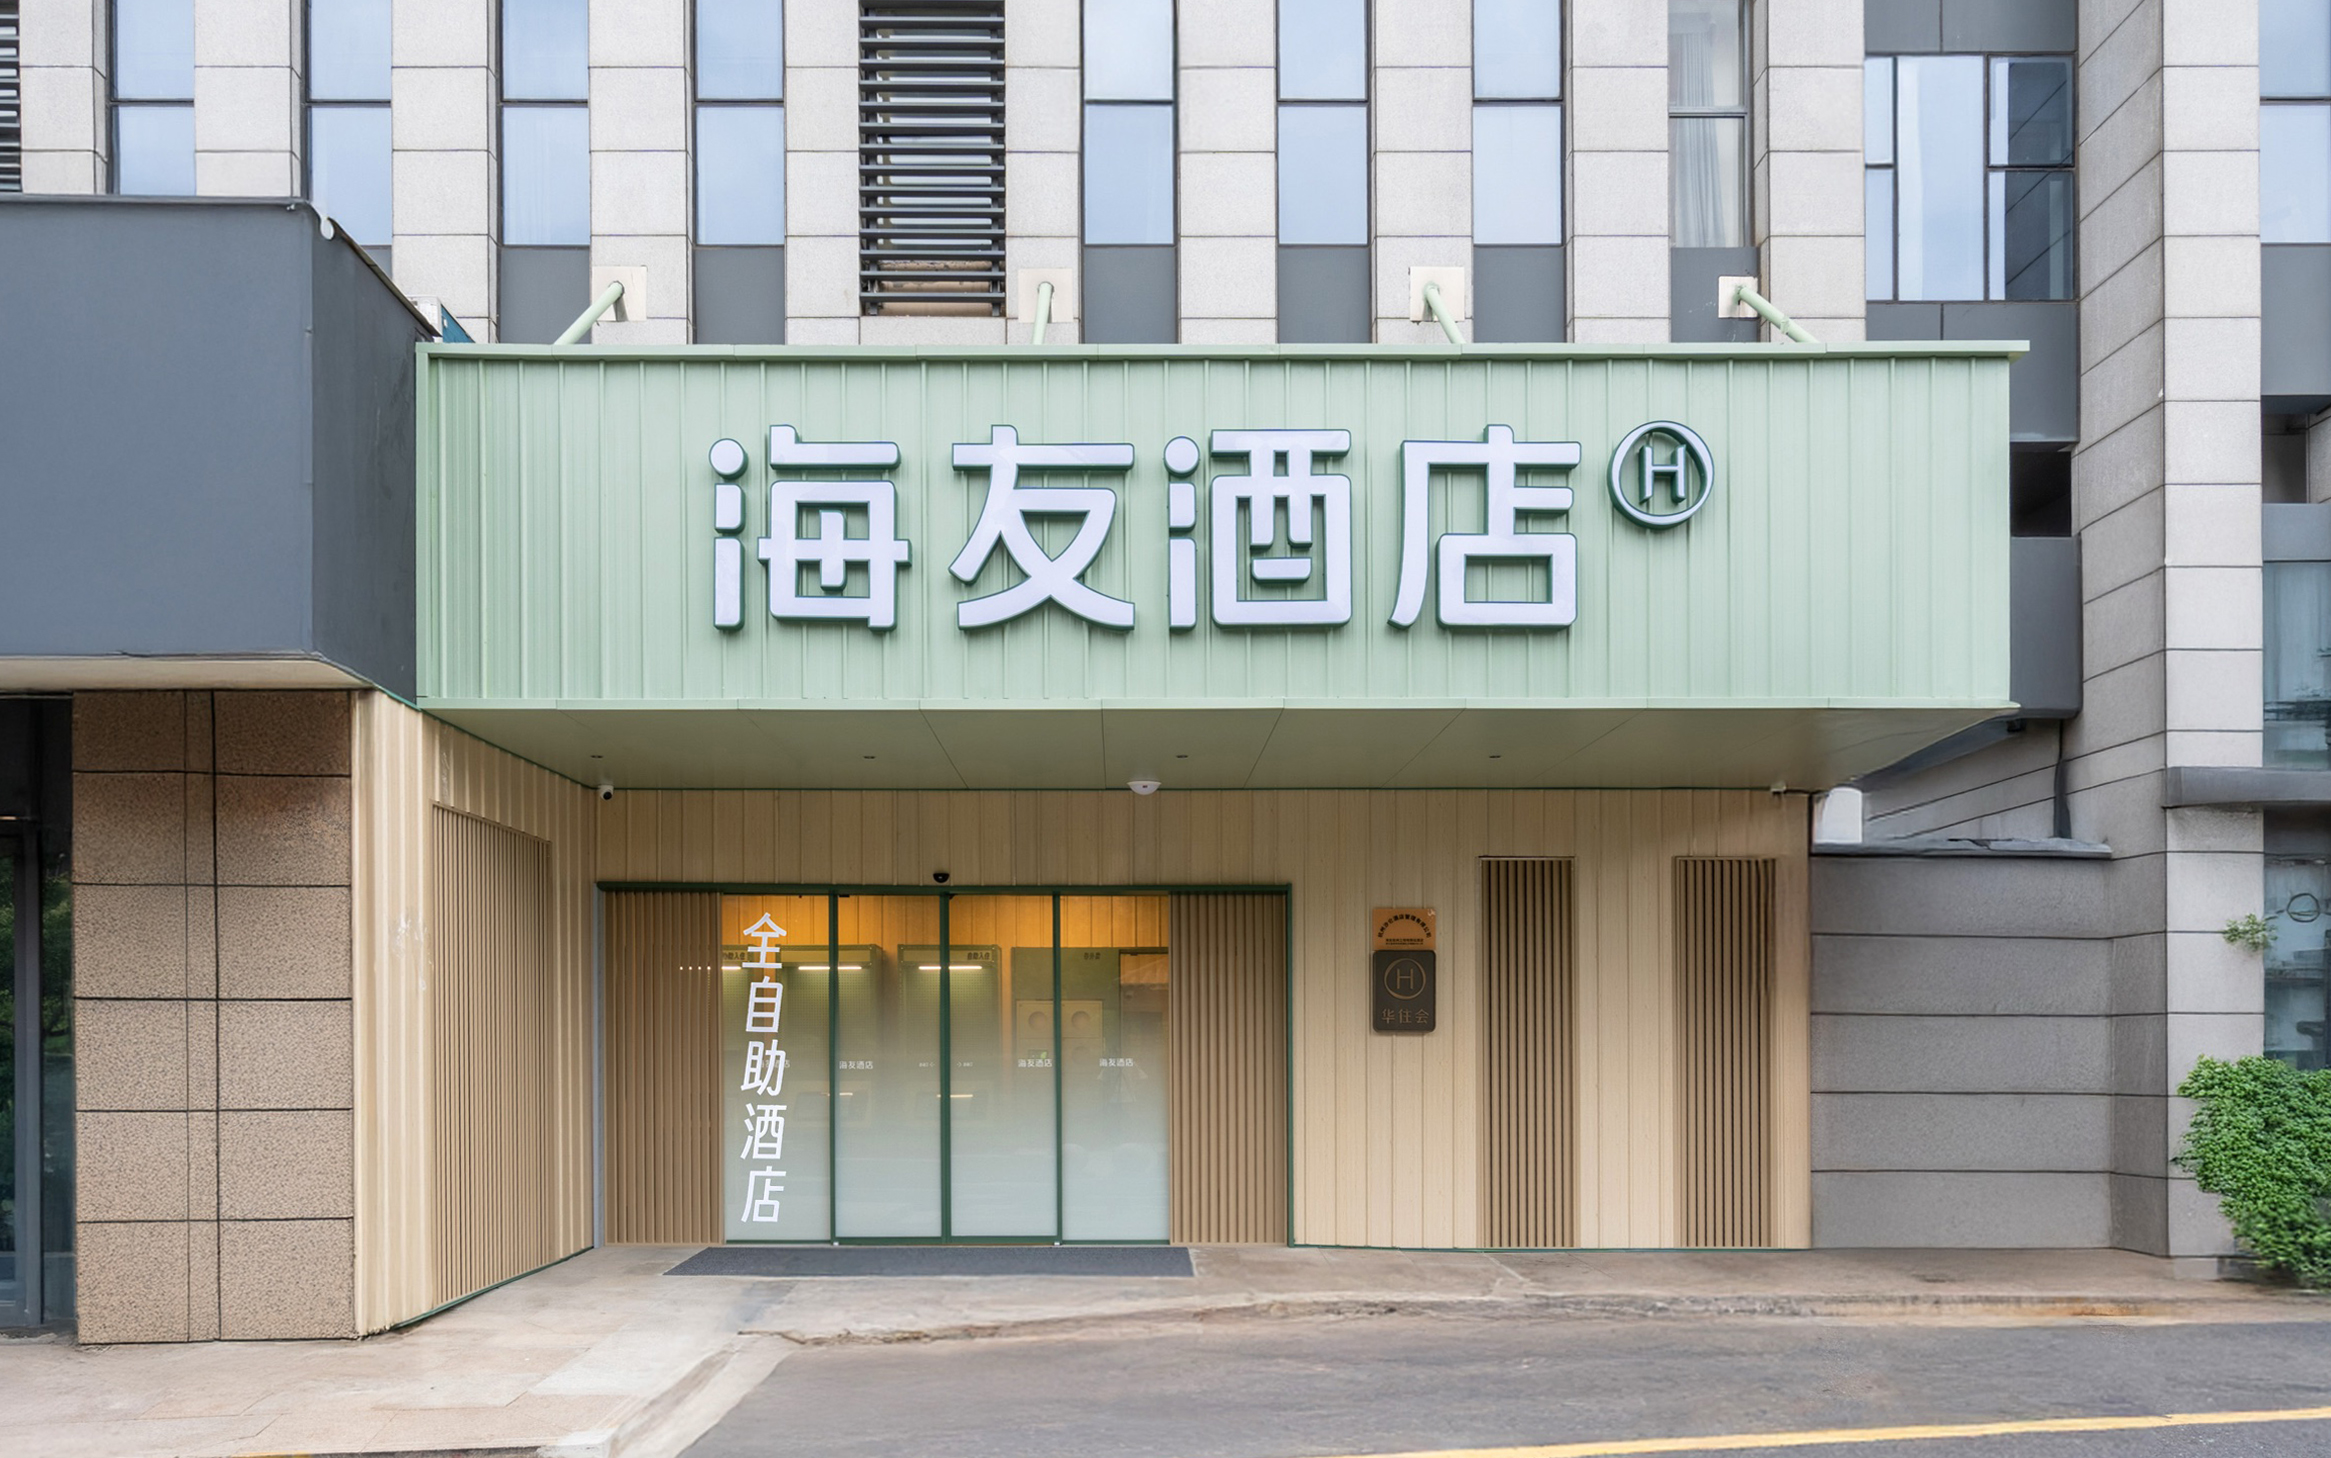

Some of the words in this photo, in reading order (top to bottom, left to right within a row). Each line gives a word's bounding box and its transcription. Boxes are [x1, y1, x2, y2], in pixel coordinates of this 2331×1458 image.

[708, 424, 1581, 632] 海友酒店
[1396, 968, 1414, 990] H
[1381, 1008, 1429, 1024] 华住会
[740, 912, 787, 1223] 全自助酒店
[839, 1060, 873, 1070] 海友酒店
[1017, 1058, 1053, 1068] 海友酒店
[1099, 1057, 1134, 1067] 海友酒店
